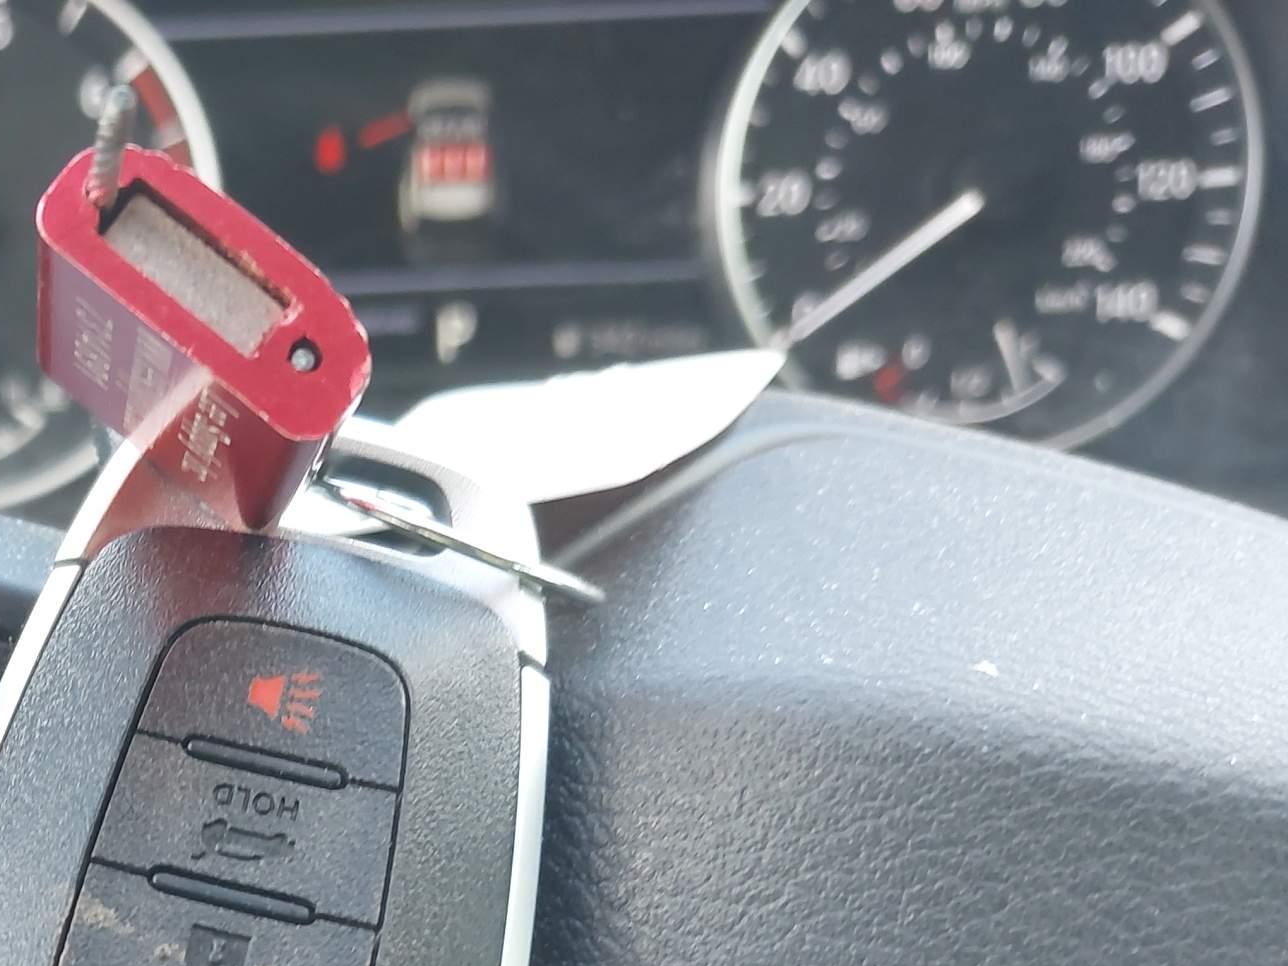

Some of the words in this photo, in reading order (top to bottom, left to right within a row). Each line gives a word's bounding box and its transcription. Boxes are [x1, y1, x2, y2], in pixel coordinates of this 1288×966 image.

[793, 49, 853, 96] 40
[756, 169, 813, 217] 20
[1136, 157, 1197, 201] 120
[436, 303, 478, 364] P
[212, 782, 301, 821] HOLD
